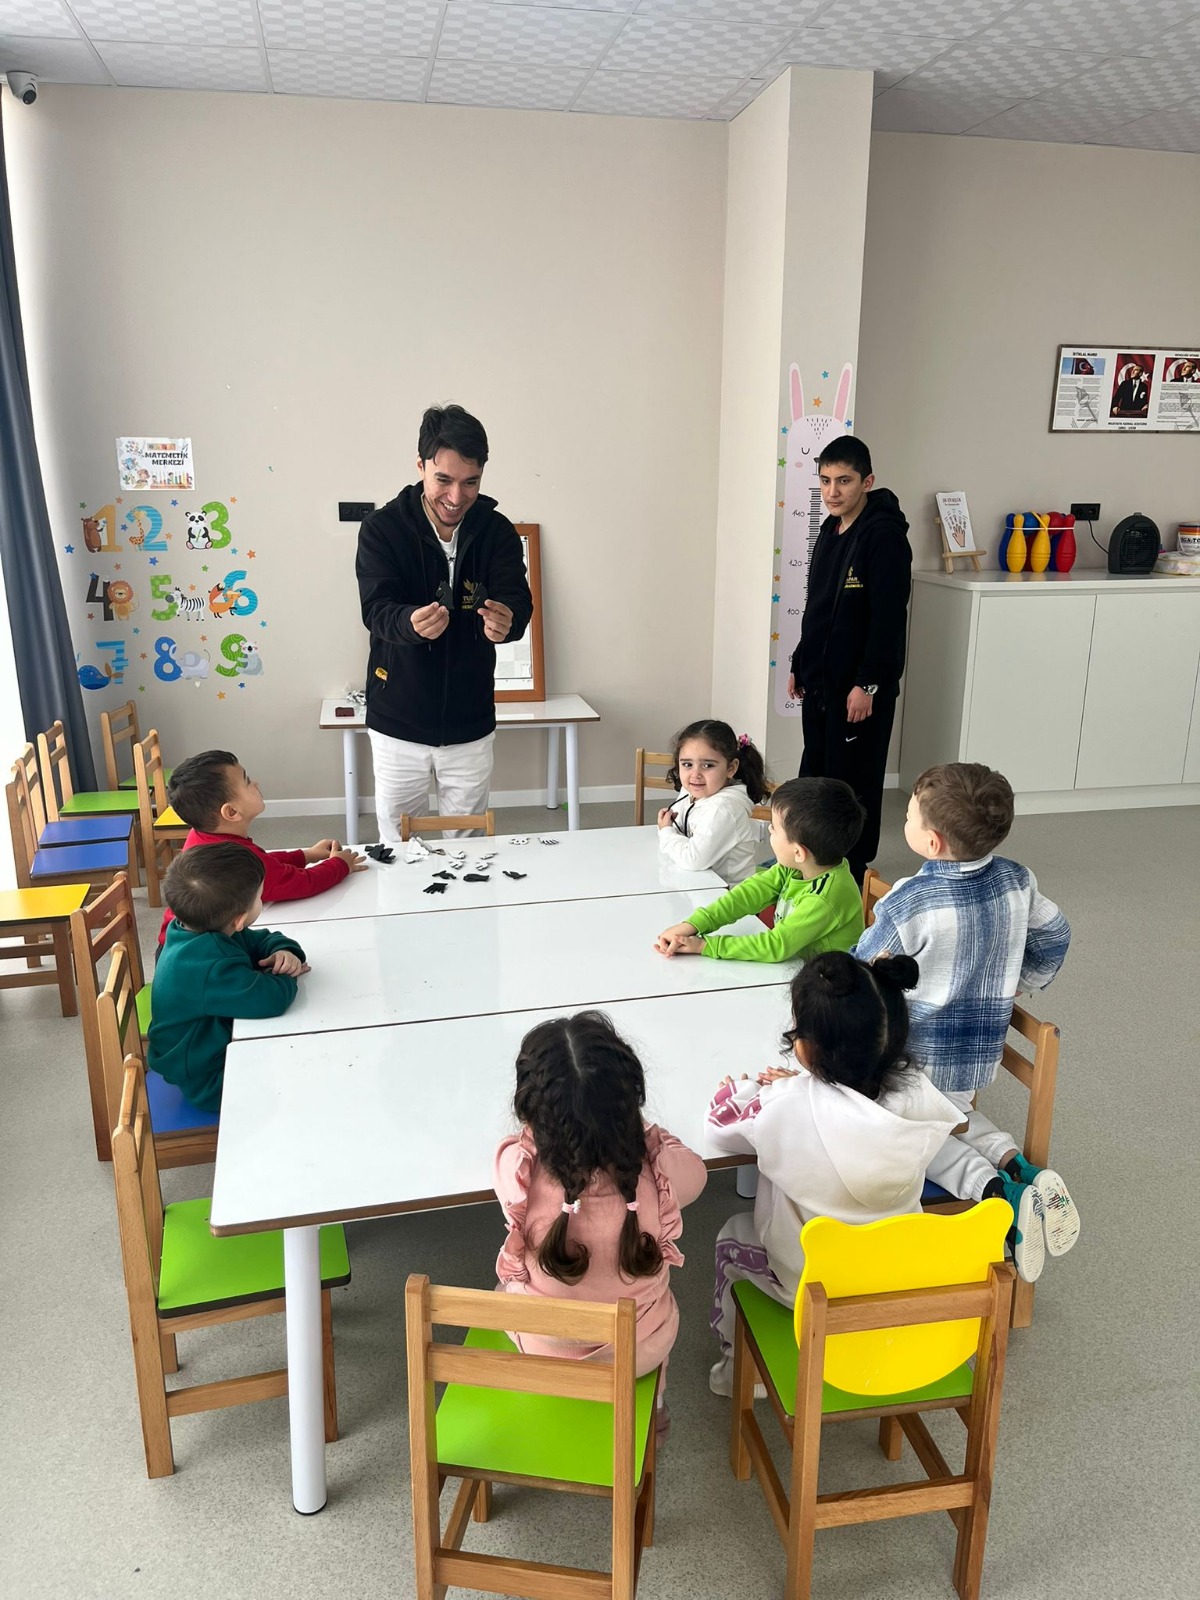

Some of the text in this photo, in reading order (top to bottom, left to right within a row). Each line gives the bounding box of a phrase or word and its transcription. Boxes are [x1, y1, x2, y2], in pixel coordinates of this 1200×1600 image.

[792, 509, 805, 517] 140
[94, 501, 231, 552] 1 2 3
[789, 559, 802, 567] 120
[86, 570, 258, 621] 4 5 6
[787, 608, 800, 616] 100
[154, 637, 182, 682] 8
[215, 634, 251, 678] 9
[785, 701, 795, 709] 60
